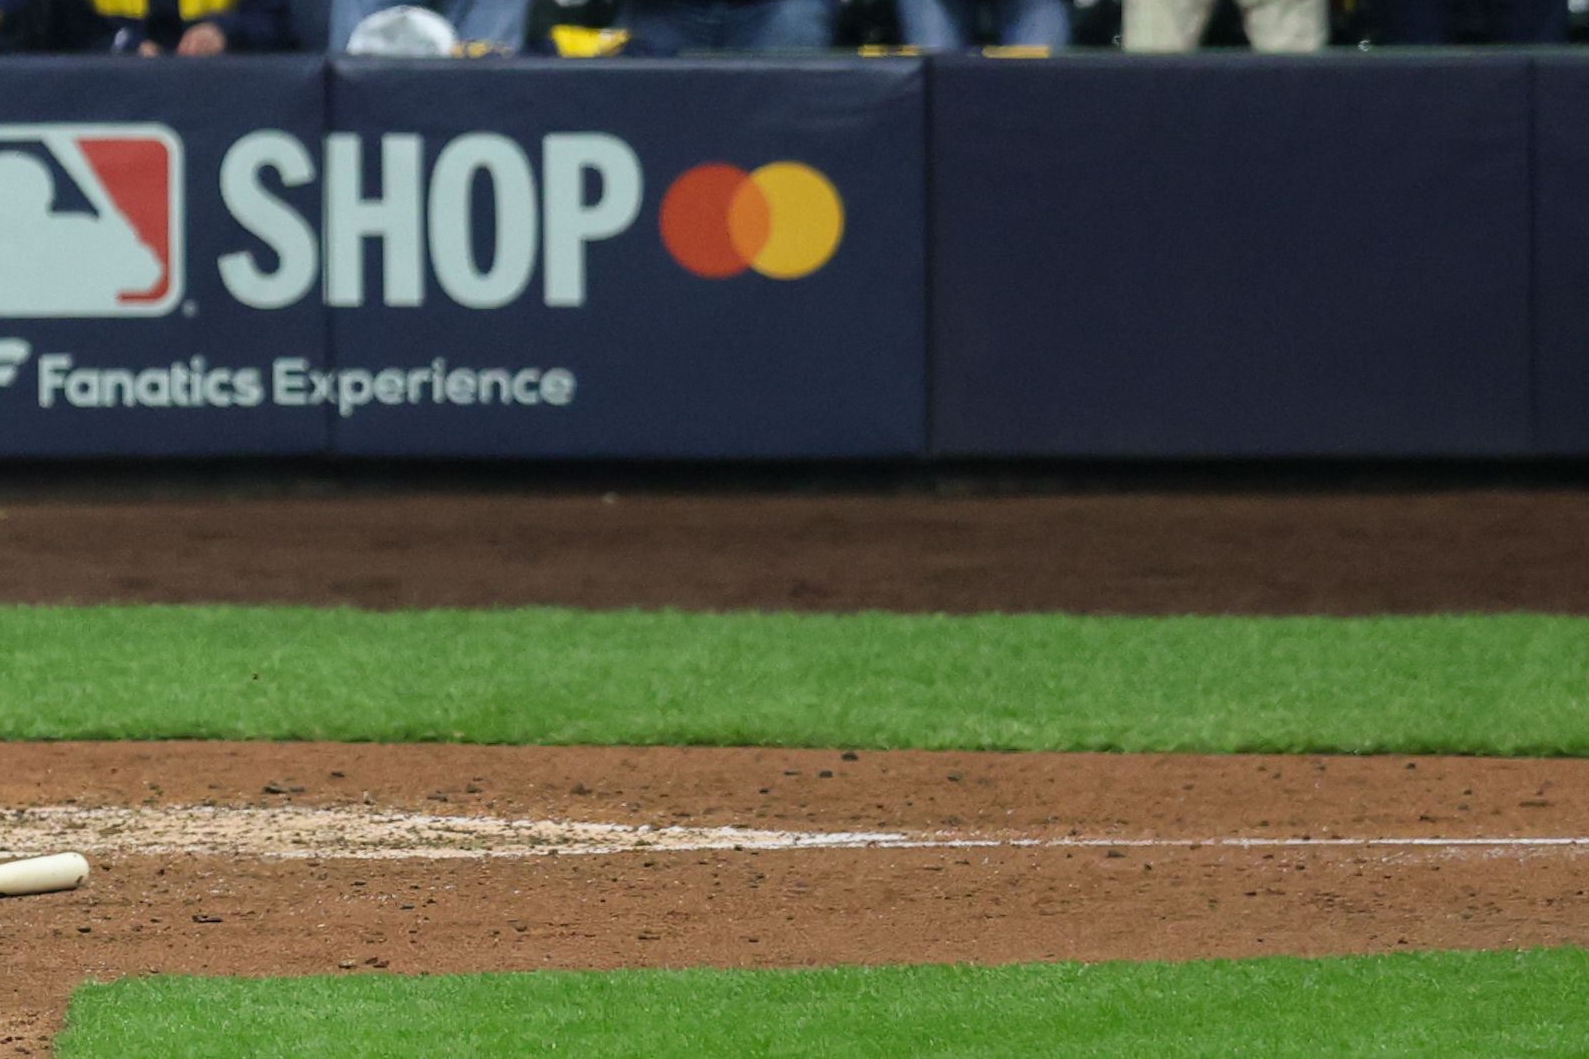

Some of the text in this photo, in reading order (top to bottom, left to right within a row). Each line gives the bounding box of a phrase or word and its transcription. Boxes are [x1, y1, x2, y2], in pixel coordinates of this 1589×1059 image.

[217, 127, 644, 310] SHOP
[37, 352, 263, 409] Fanatics
[271, 355, 577, 419] Experience
